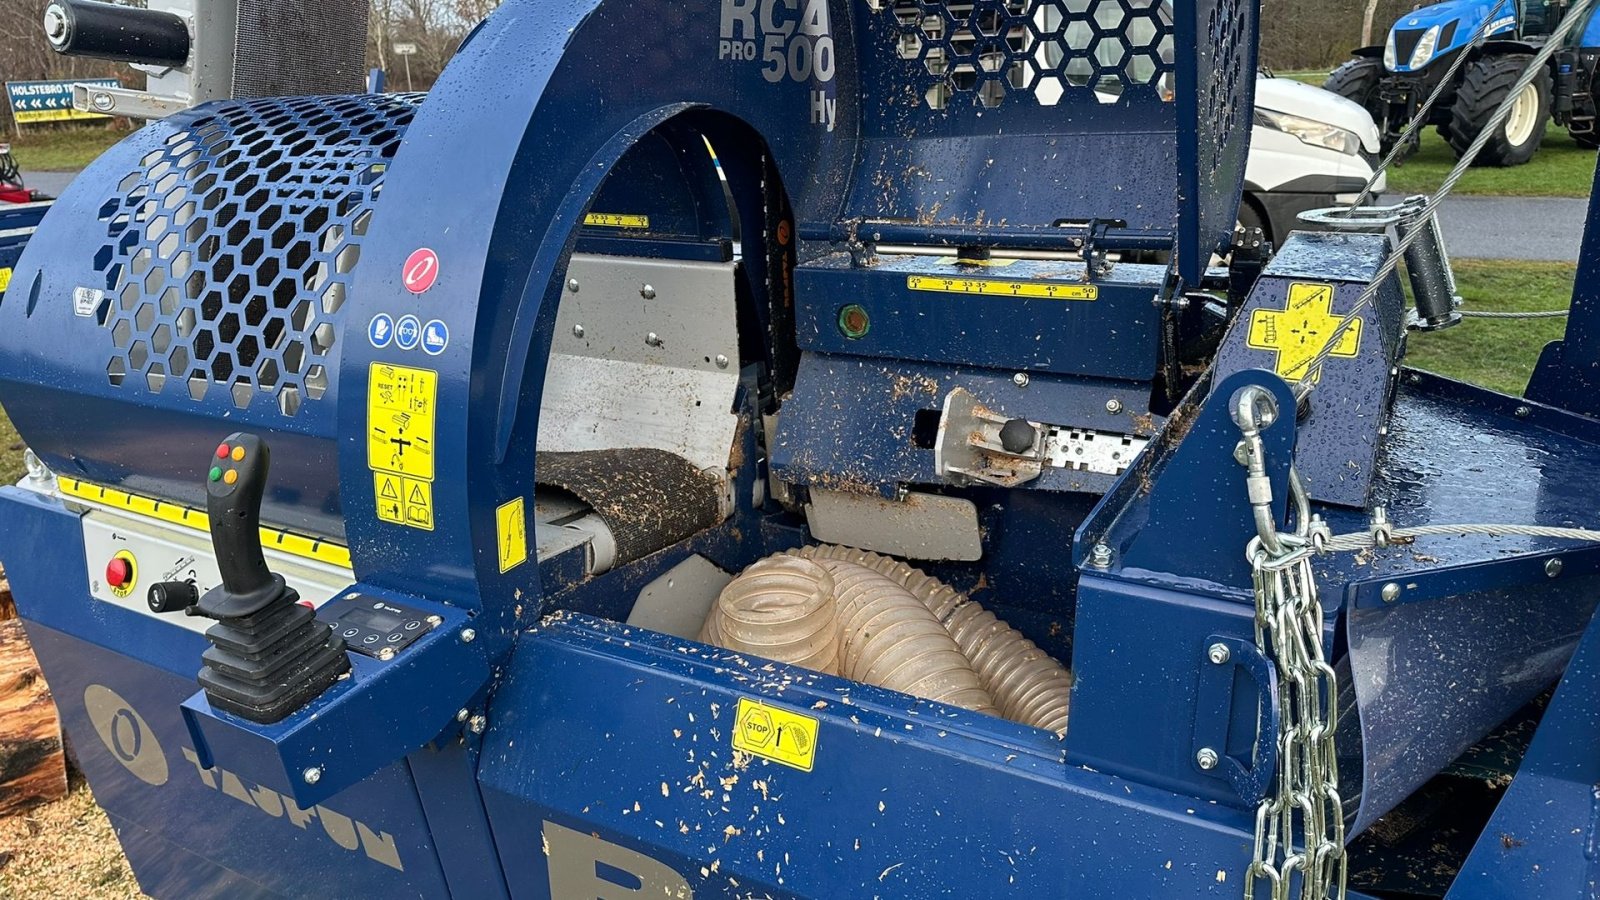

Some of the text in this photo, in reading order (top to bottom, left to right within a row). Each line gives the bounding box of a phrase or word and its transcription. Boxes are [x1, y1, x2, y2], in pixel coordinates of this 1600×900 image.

[720, 0, 829, 39] RCA
[719, 34, 836, 83] PRO 500
[11, 84, 63, 95] HOLSTEBRO
[810, 90, 837, 132] Hy
[378, 383, 393, 391] RESET
[113, 587, 127, 598] STOP
[746, 721, 768, 734] STOP
